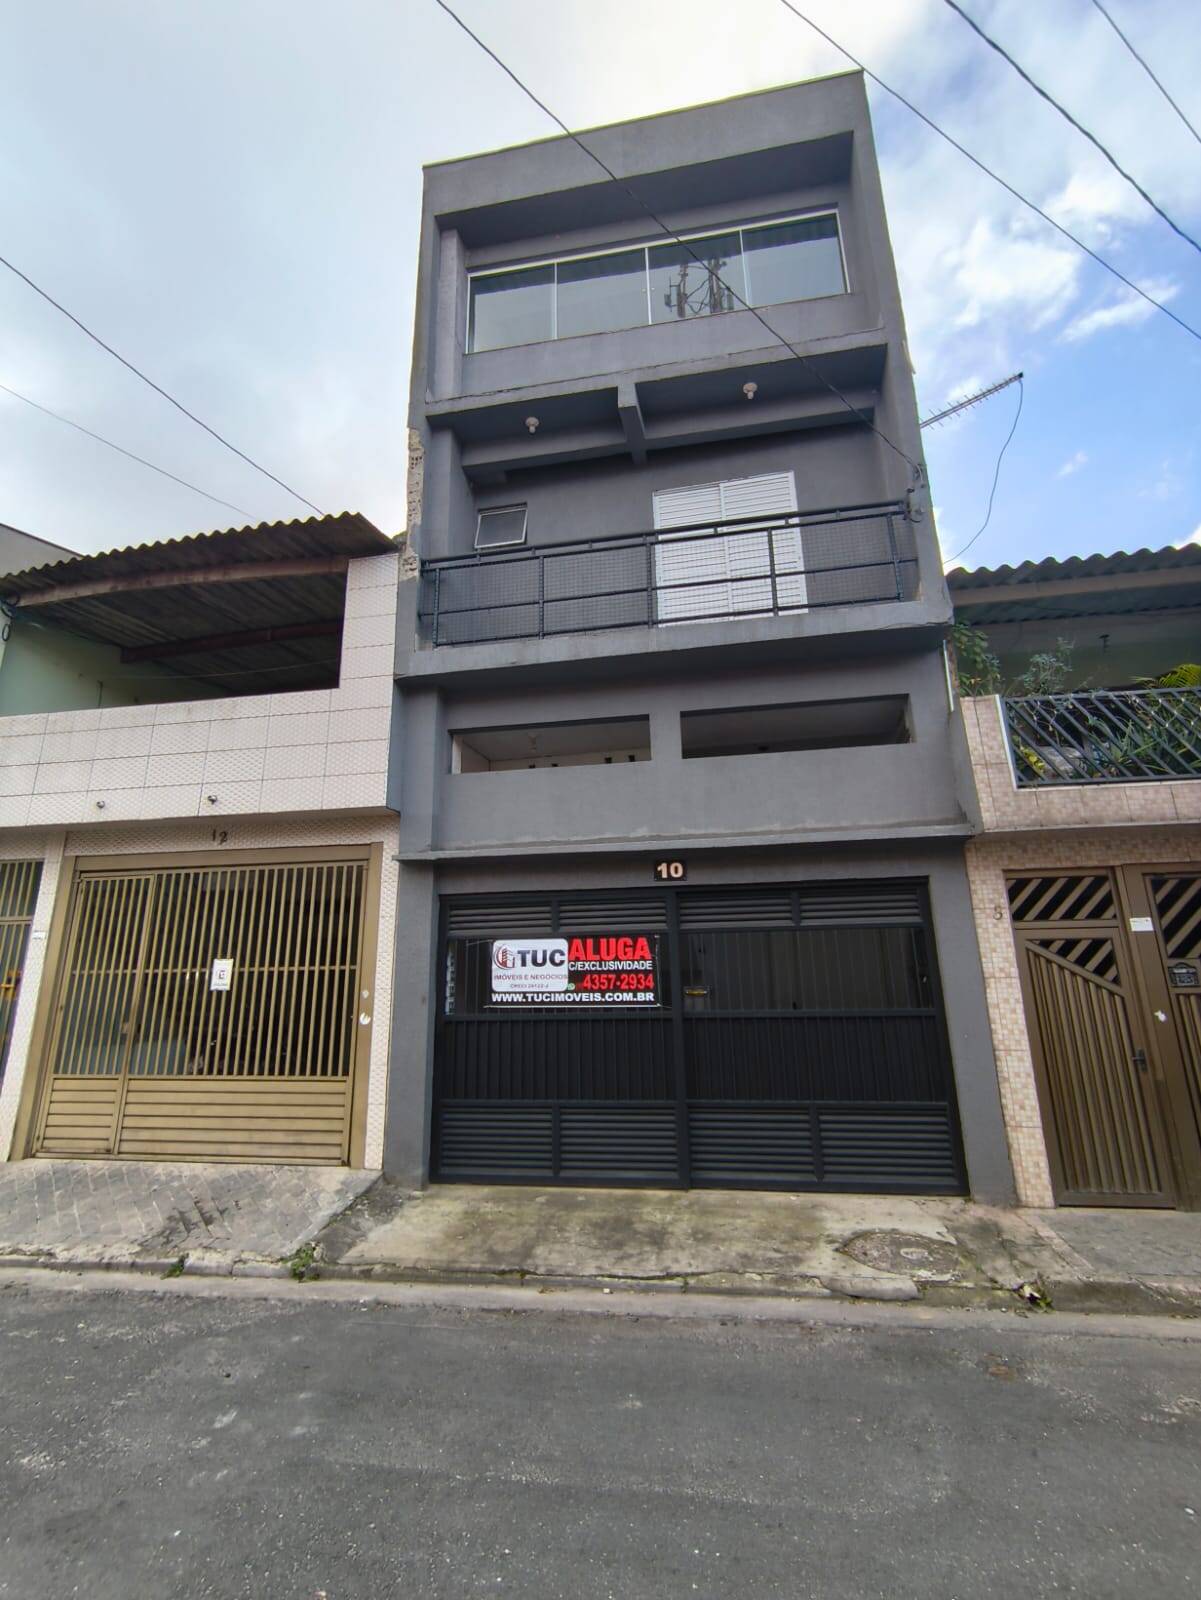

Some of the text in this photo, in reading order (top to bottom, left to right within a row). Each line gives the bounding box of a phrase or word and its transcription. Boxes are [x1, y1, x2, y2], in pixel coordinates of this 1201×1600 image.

[657, 862, 683, 879] 10
[568, 937, 652, 960] ALUGA
[517, 948, 566, 968] TUC
[568, 960, 653, 971] C/EXCLUSIVIDADE
[583, 973, 655, 990] 4357-2934
[491, 992, 655, 1003] WWW.TUCIMOVEIS.COM.BR
